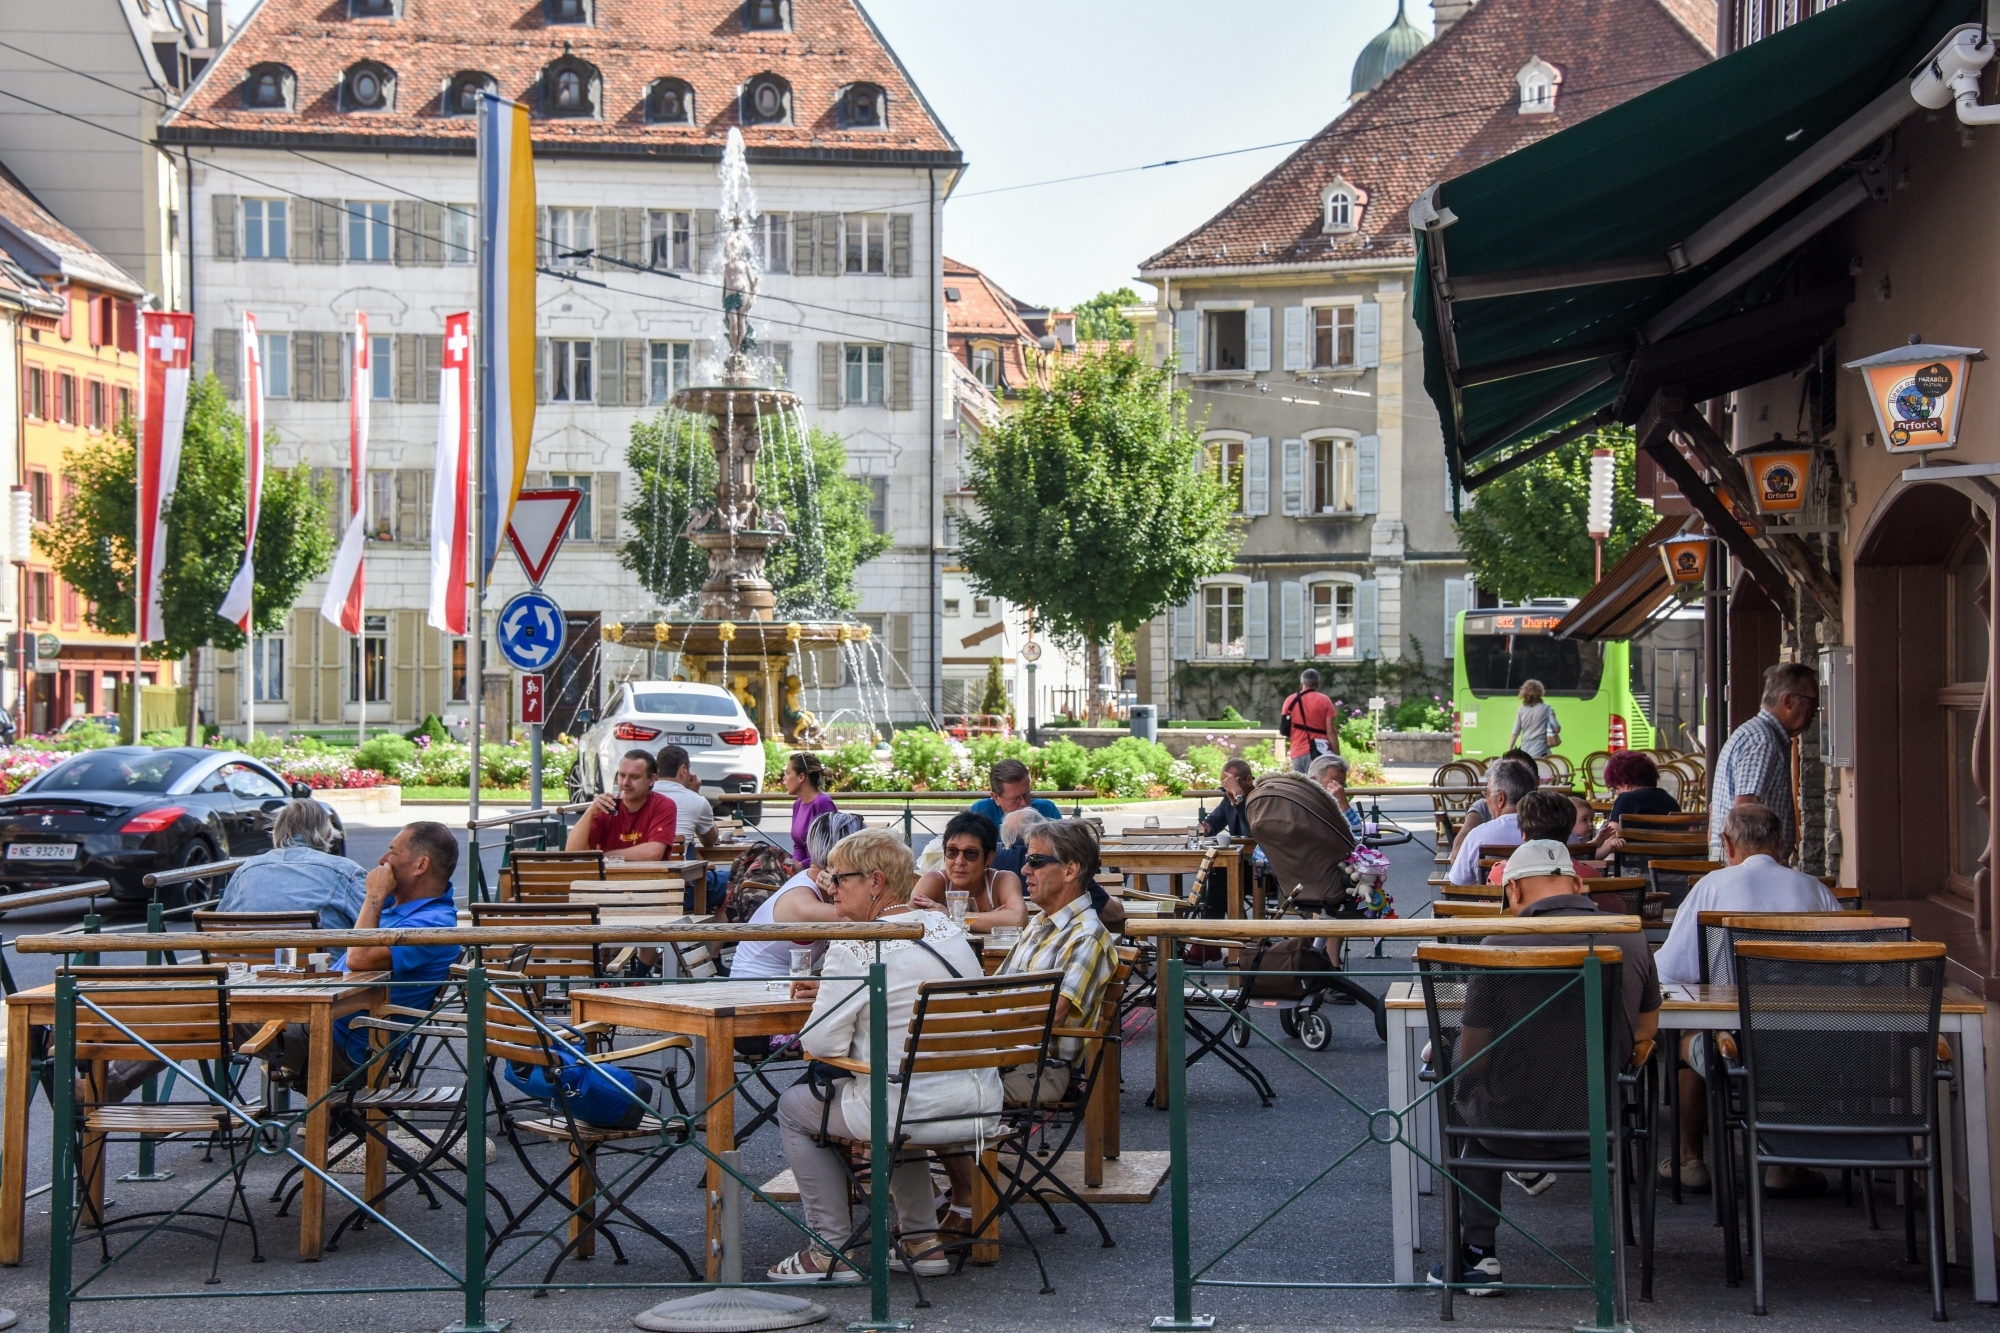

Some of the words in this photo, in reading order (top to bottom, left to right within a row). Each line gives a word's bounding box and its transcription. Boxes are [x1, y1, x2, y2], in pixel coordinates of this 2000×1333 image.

[1767, 492, 1794, 500] Orforte
[1497, 616, 1514, 628] 302
[19, 846, 32, 857] NE
[36, 846, 66, 857] 93276
